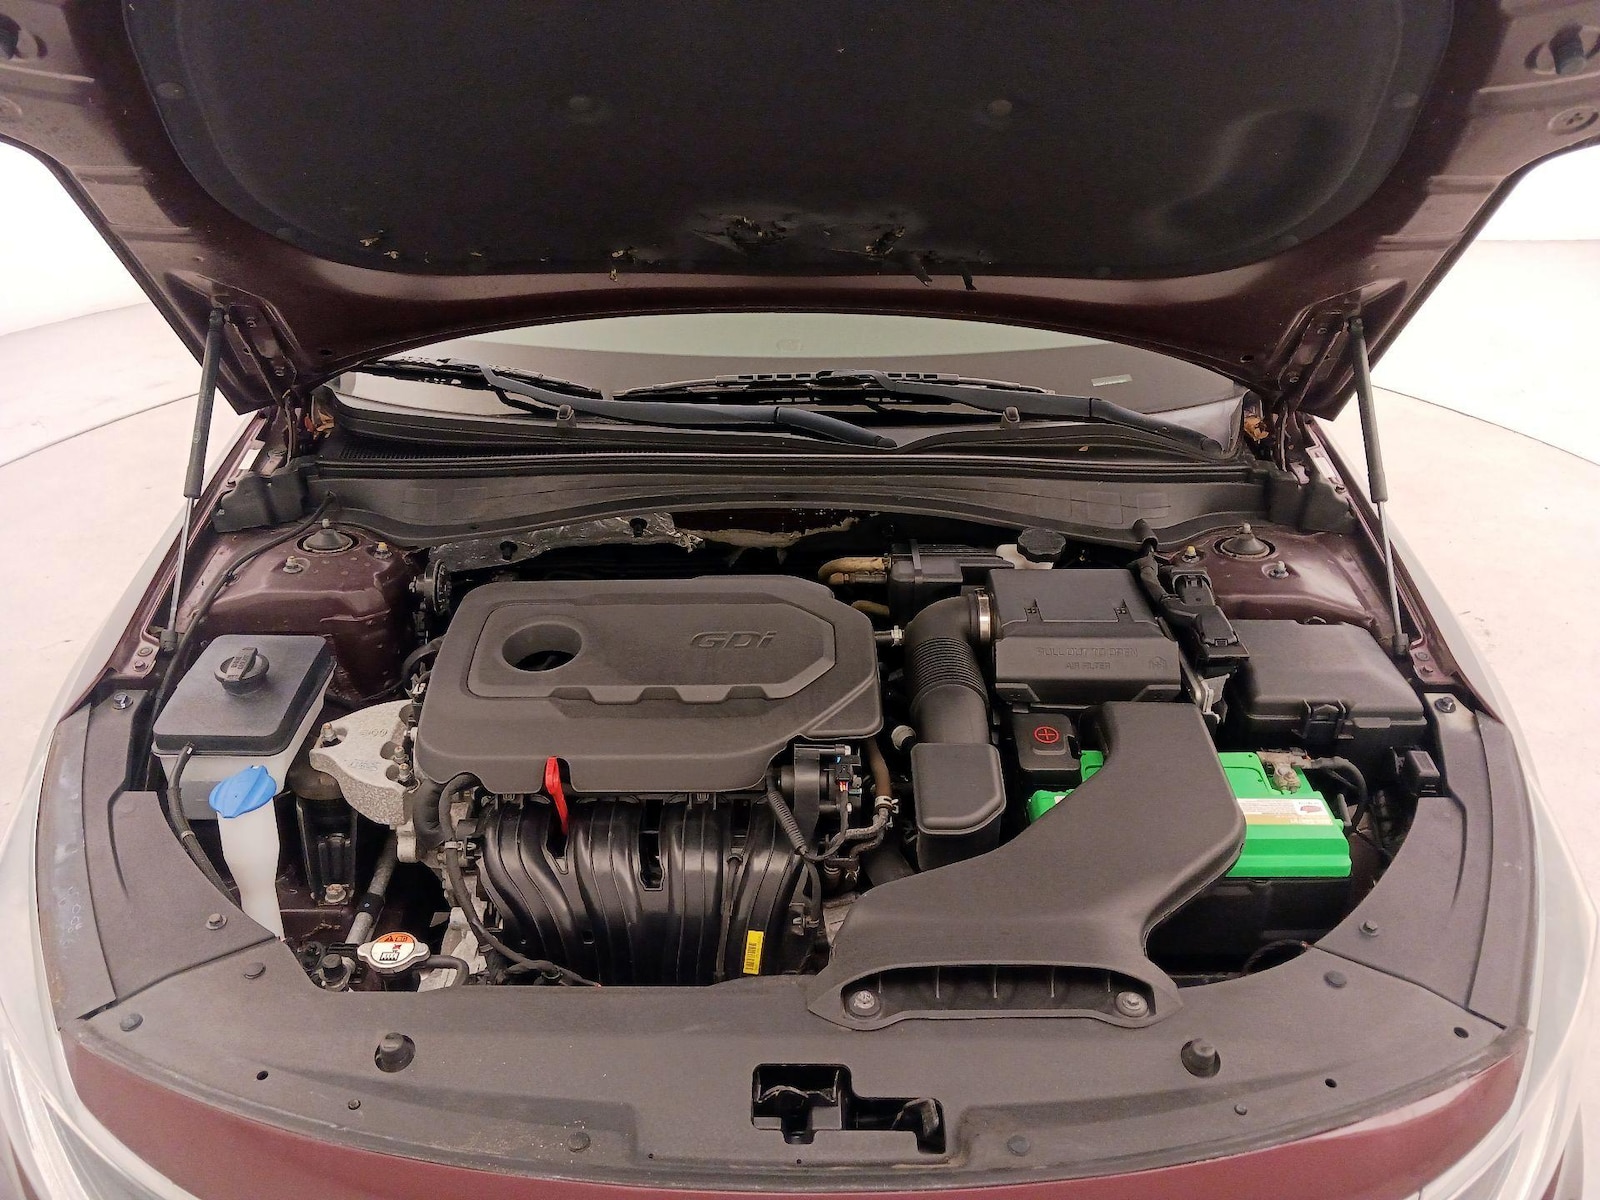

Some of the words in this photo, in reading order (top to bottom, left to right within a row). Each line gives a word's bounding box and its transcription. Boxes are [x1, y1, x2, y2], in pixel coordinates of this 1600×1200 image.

[690, 630, 778, 649] GDi
[1067, 646, 1088, 657] OUT
[1091, 646, 1106, 657] TO
[1065, 661, 1081, 670] AIR
[1082, 661, 1111, 670] FILTER
